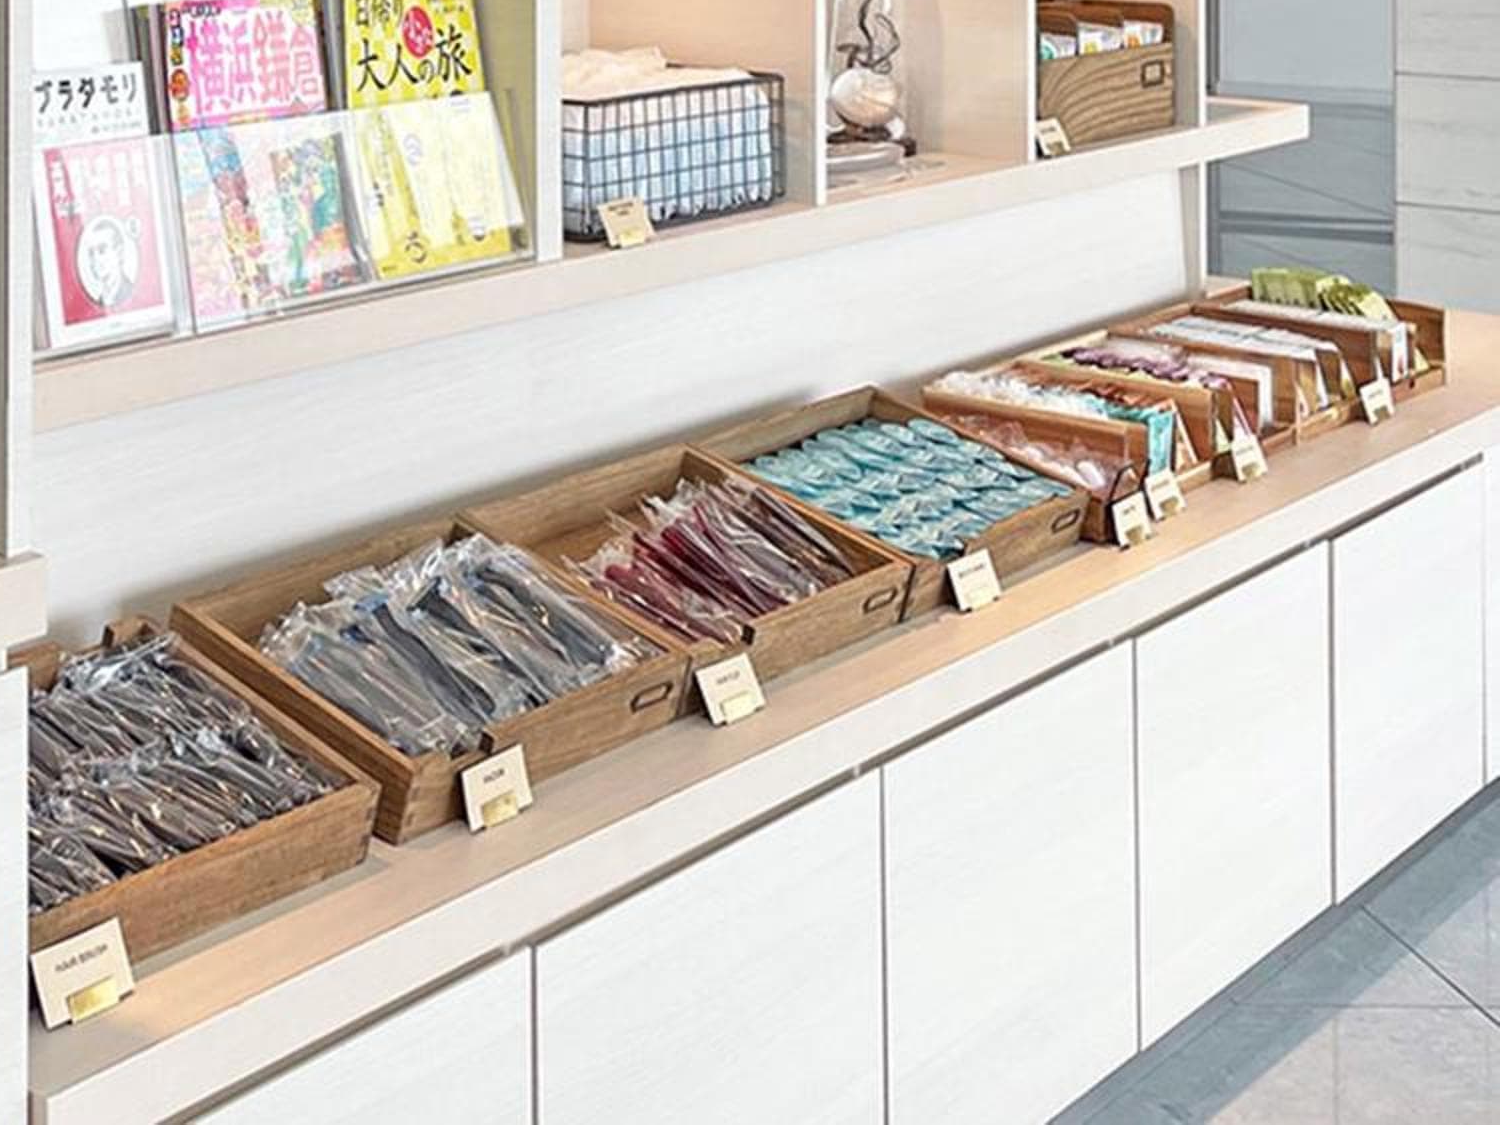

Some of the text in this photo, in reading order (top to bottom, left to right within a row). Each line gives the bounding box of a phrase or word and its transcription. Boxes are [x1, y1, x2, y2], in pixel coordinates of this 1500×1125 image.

[356, 23, 473, 92] 大人の旅
[34, 72, 137, 114] ブラタモリ
